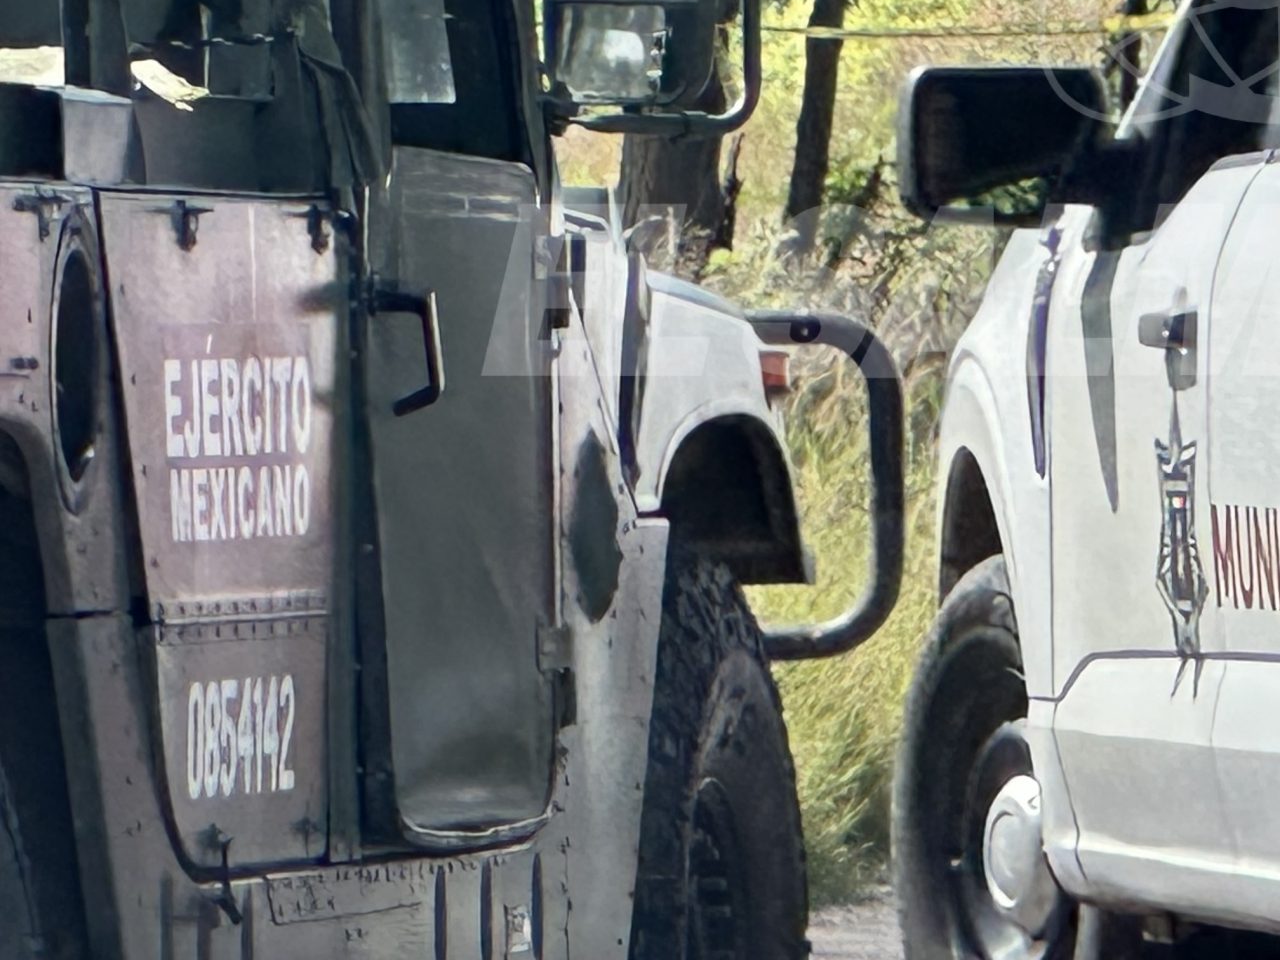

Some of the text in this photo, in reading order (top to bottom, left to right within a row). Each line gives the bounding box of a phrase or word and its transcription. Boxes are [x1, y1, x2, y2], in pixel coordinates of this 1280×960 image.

[164, 334, 311, 458] EJÉRCITO
[169, 464, 310, 541] MEXICANO
[187, 674, 295, 799] 0854142
